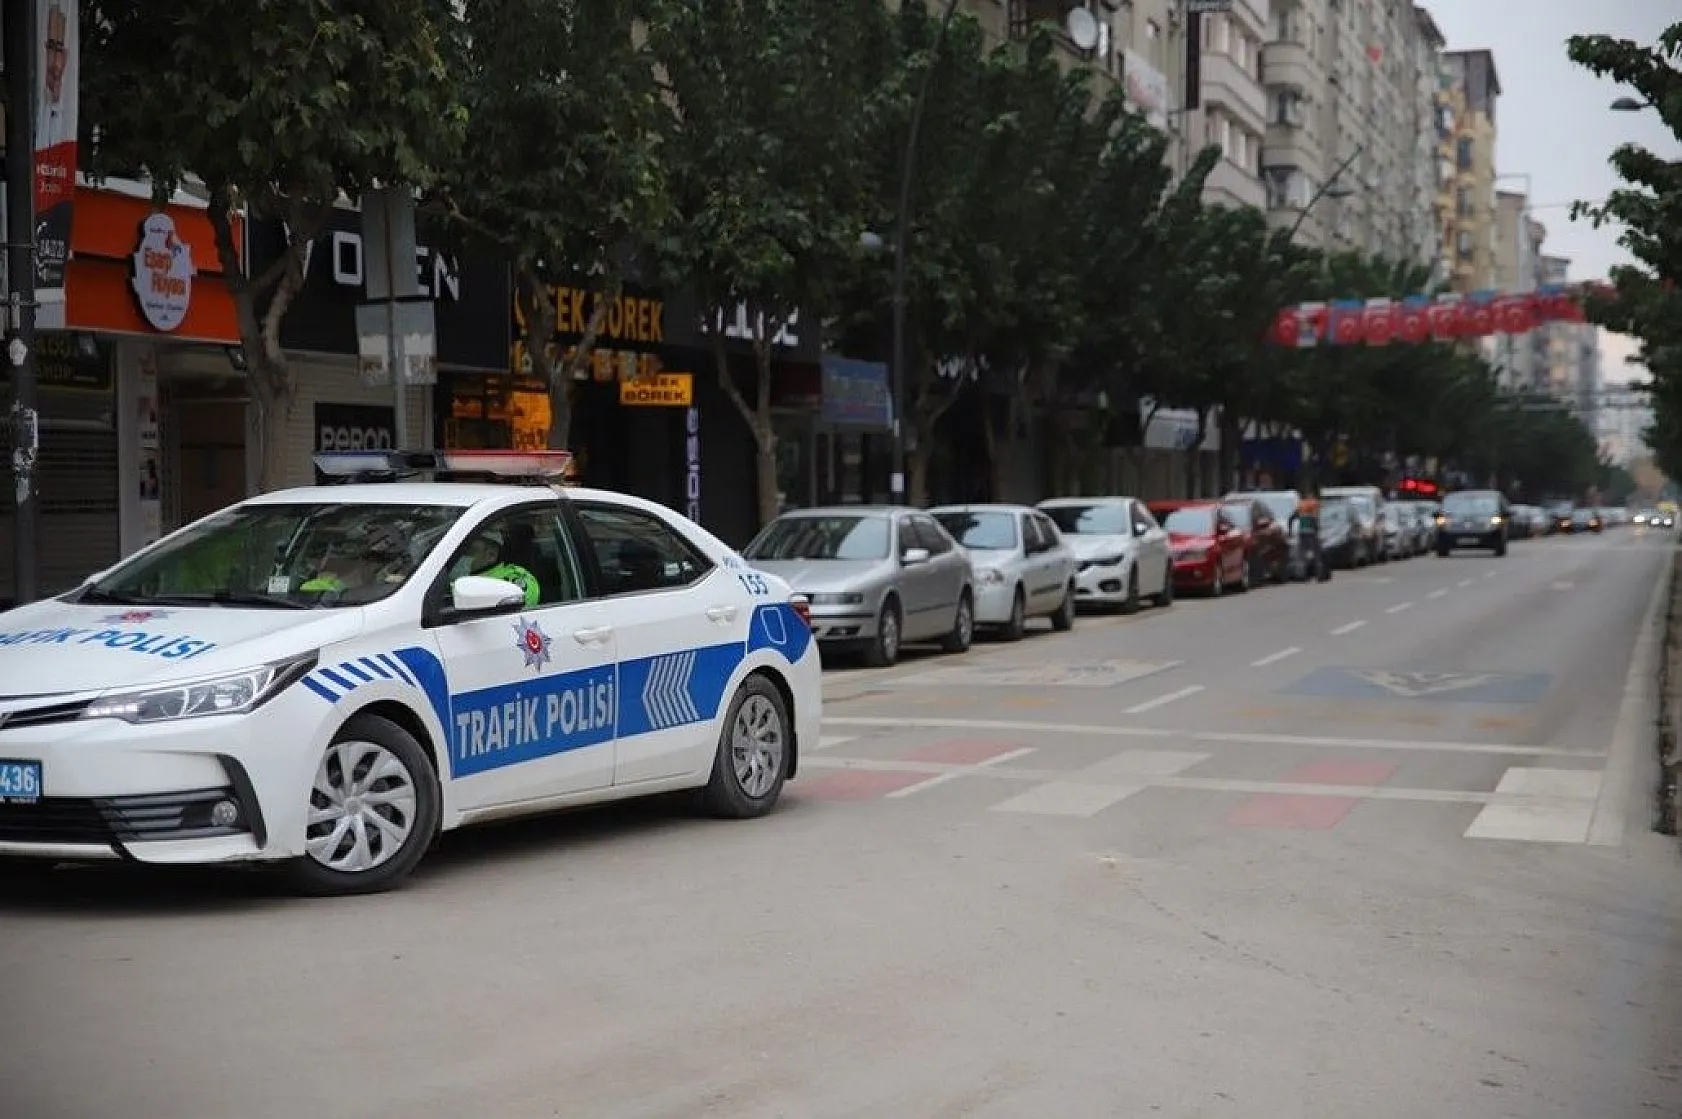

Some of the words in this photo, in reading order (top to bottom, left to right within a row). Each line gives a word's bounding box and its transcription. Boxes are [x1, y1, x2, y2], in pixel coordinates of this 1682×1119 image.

[738, 574, 768, 595] 155
[456, 692, 540, 760] TRAFİK
[547, 675, 614, 738] POLİSİ
